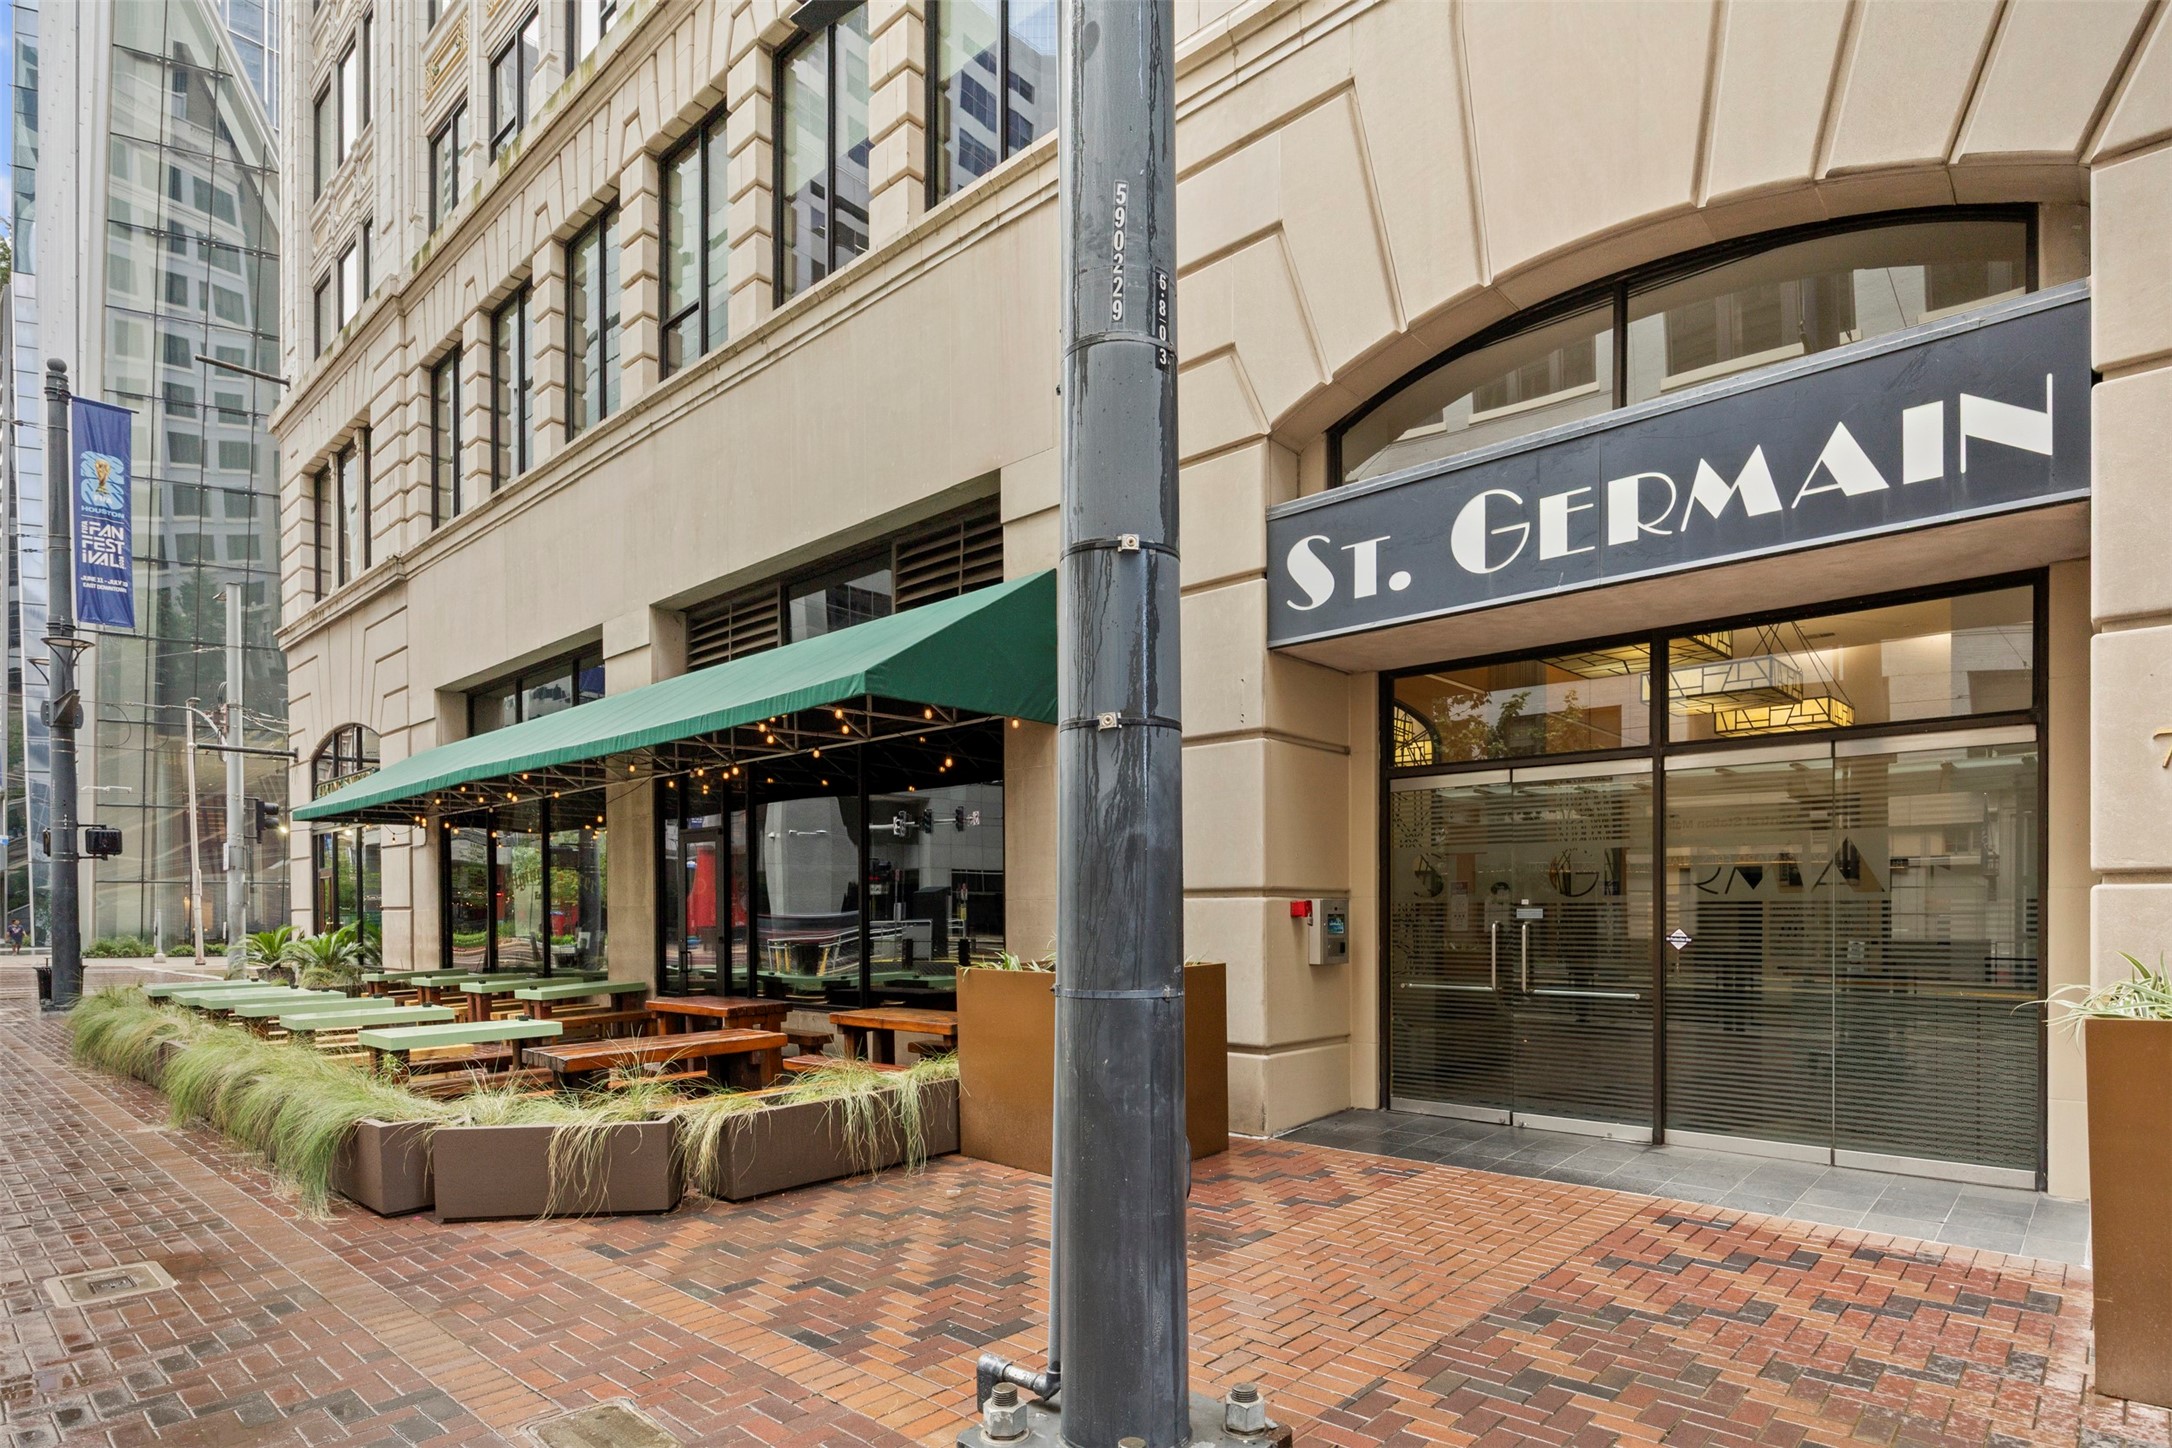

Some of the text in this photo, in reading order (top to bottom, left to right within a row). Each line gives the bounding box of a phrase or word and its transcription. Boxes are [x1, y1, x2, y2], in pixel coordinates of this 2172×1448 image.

[1112, 183, 1127, 321] 590229
[1450, 372, 2053, 575] GERMAIN
[81, 505, 125, 519] HOUSTON
[89, 521, 124, 541] FAN
[81, 534, 125, 555] FEST
[97, 584, 128, 593] DOWNTOWN
